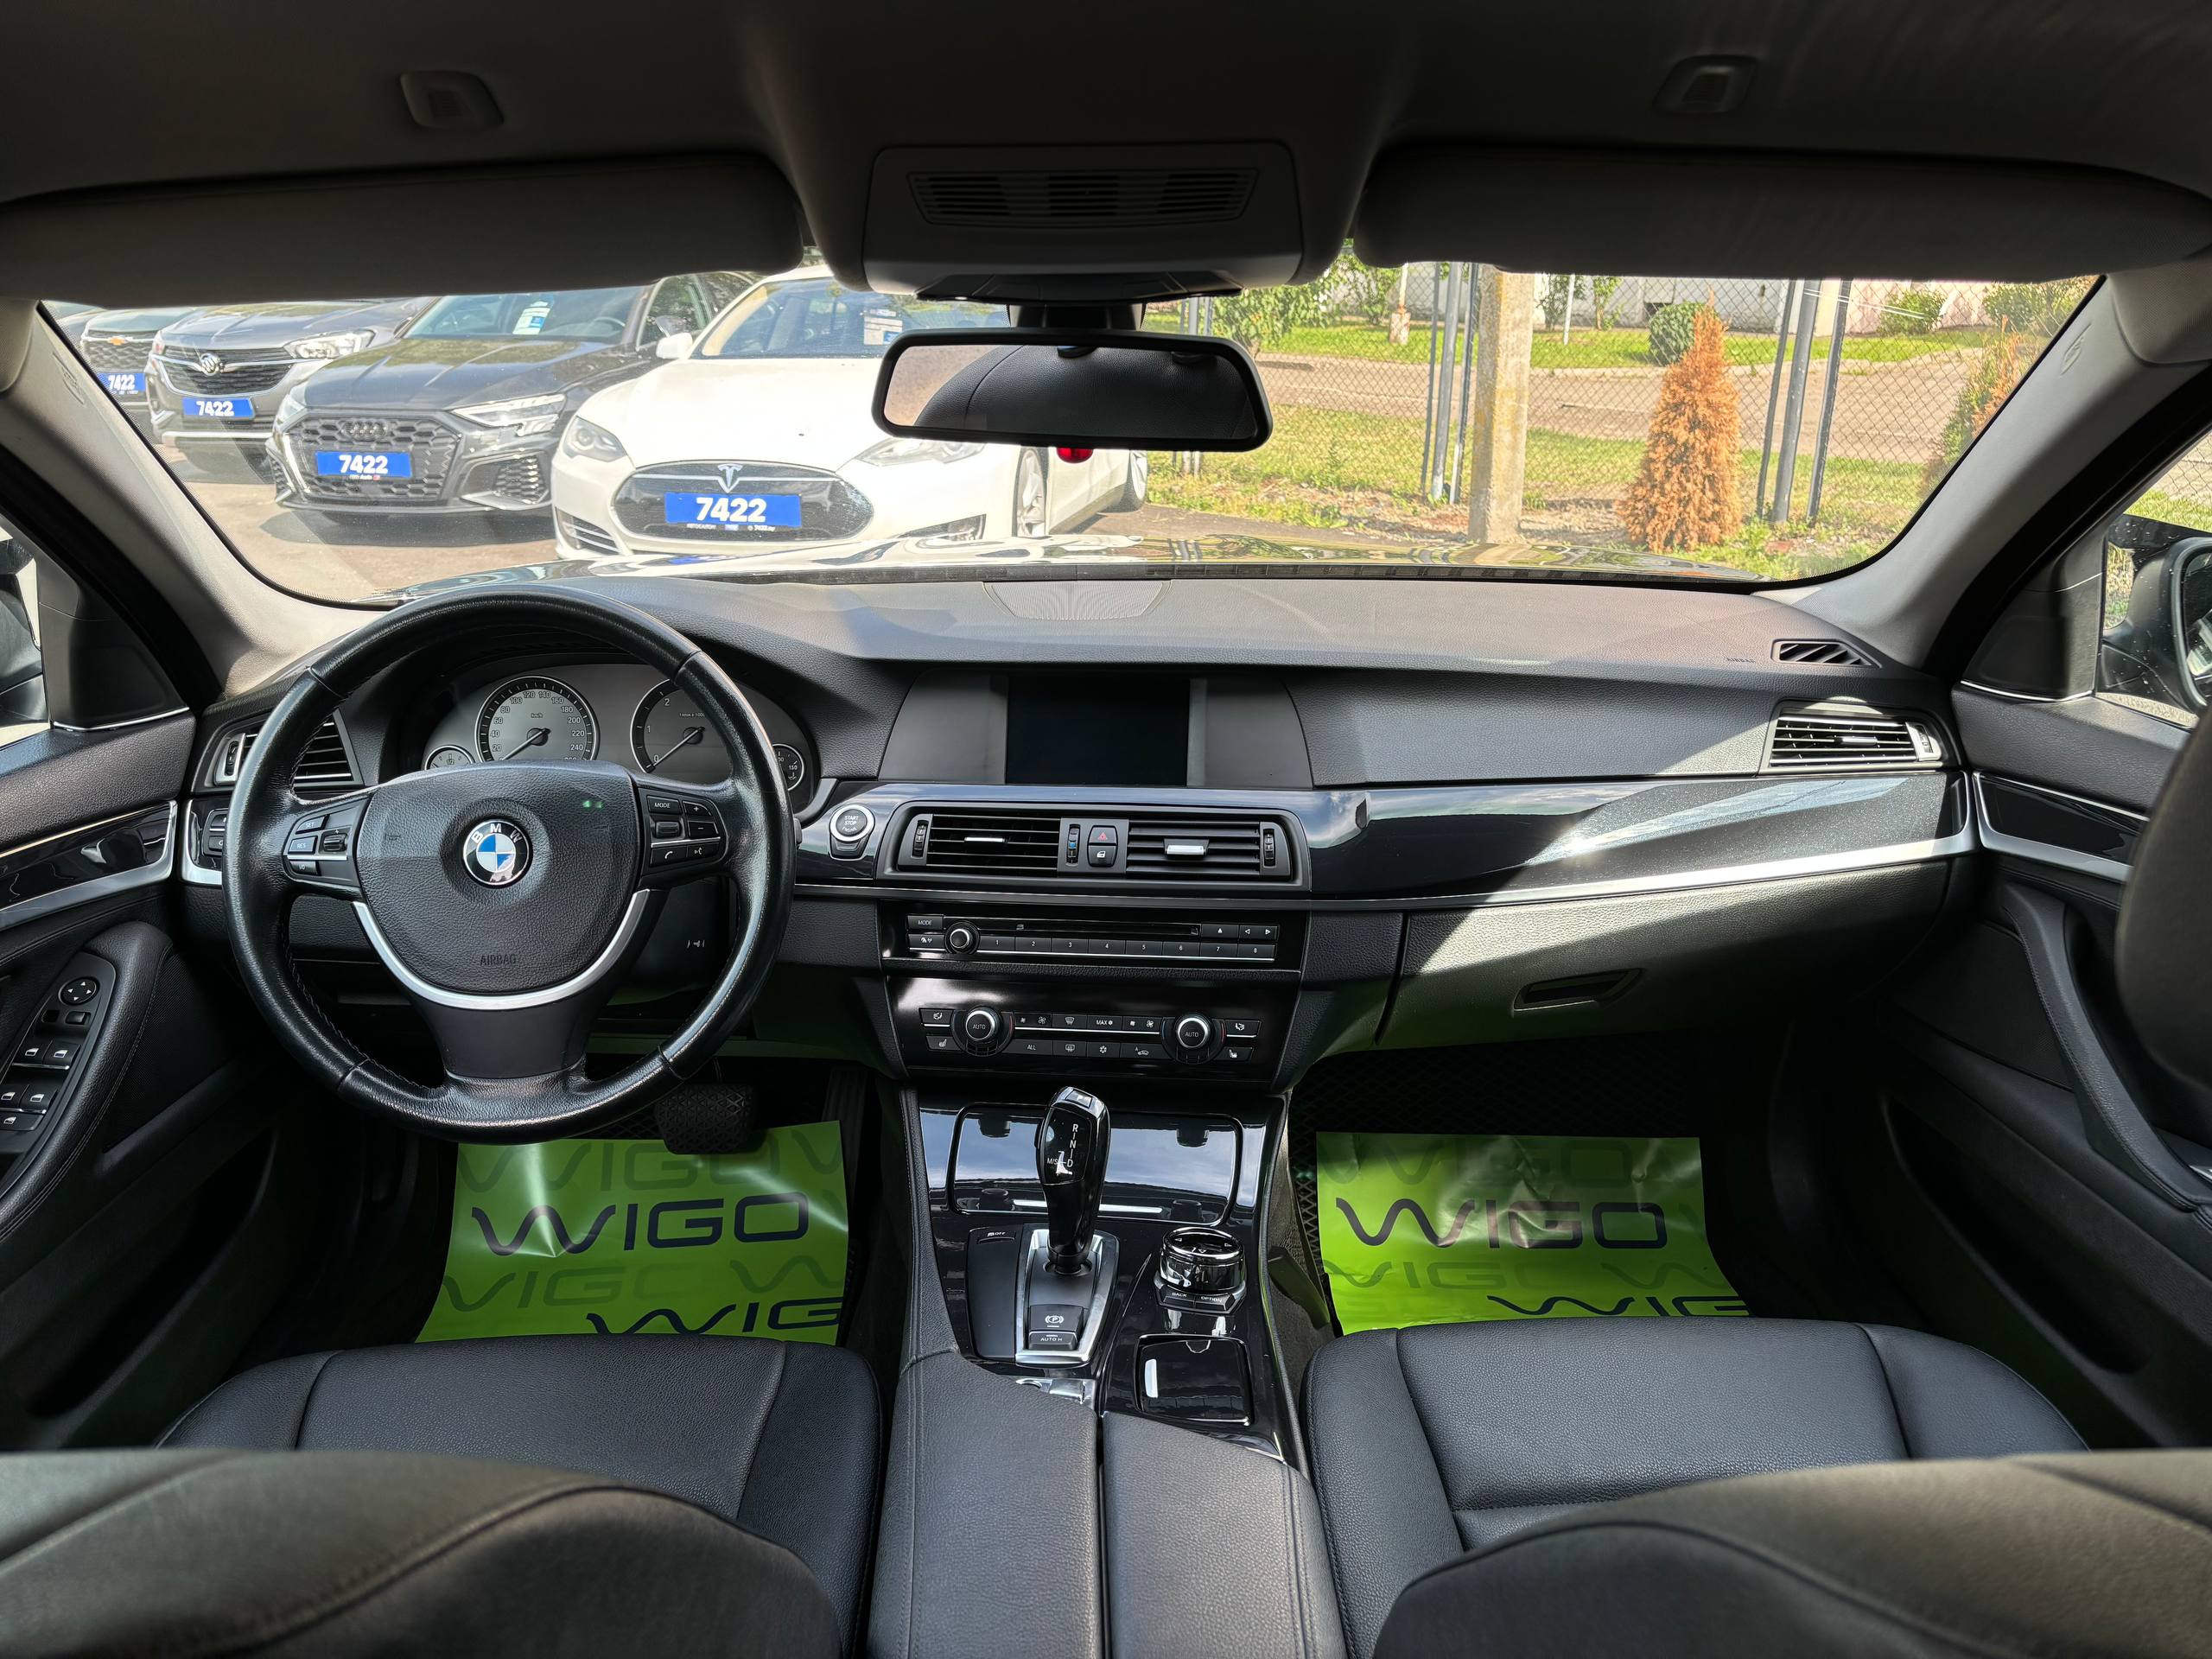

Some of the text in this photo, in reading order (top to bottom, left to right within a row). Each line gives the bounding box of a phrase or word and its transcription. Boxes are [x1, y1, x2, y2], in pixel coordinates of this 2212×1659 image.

[108, 374, 135, 391] 7422
[196, 400, 235, 416] 7422
[338, 454, 388, 474] 7422
[696, 497, 767, 523] 7422
[470, 823, 523, 844] BMW
[480, 954, 517, 966] AIRBAG
[1072, 1123, 1079, 1133] R
[1069, 1140, 1077, 1149] N
[1066, 1159, 1073, 1167] D
[471, 1192, 810, 1256] WIGO
[1336, 1197, 1668, 1249] WIGO
